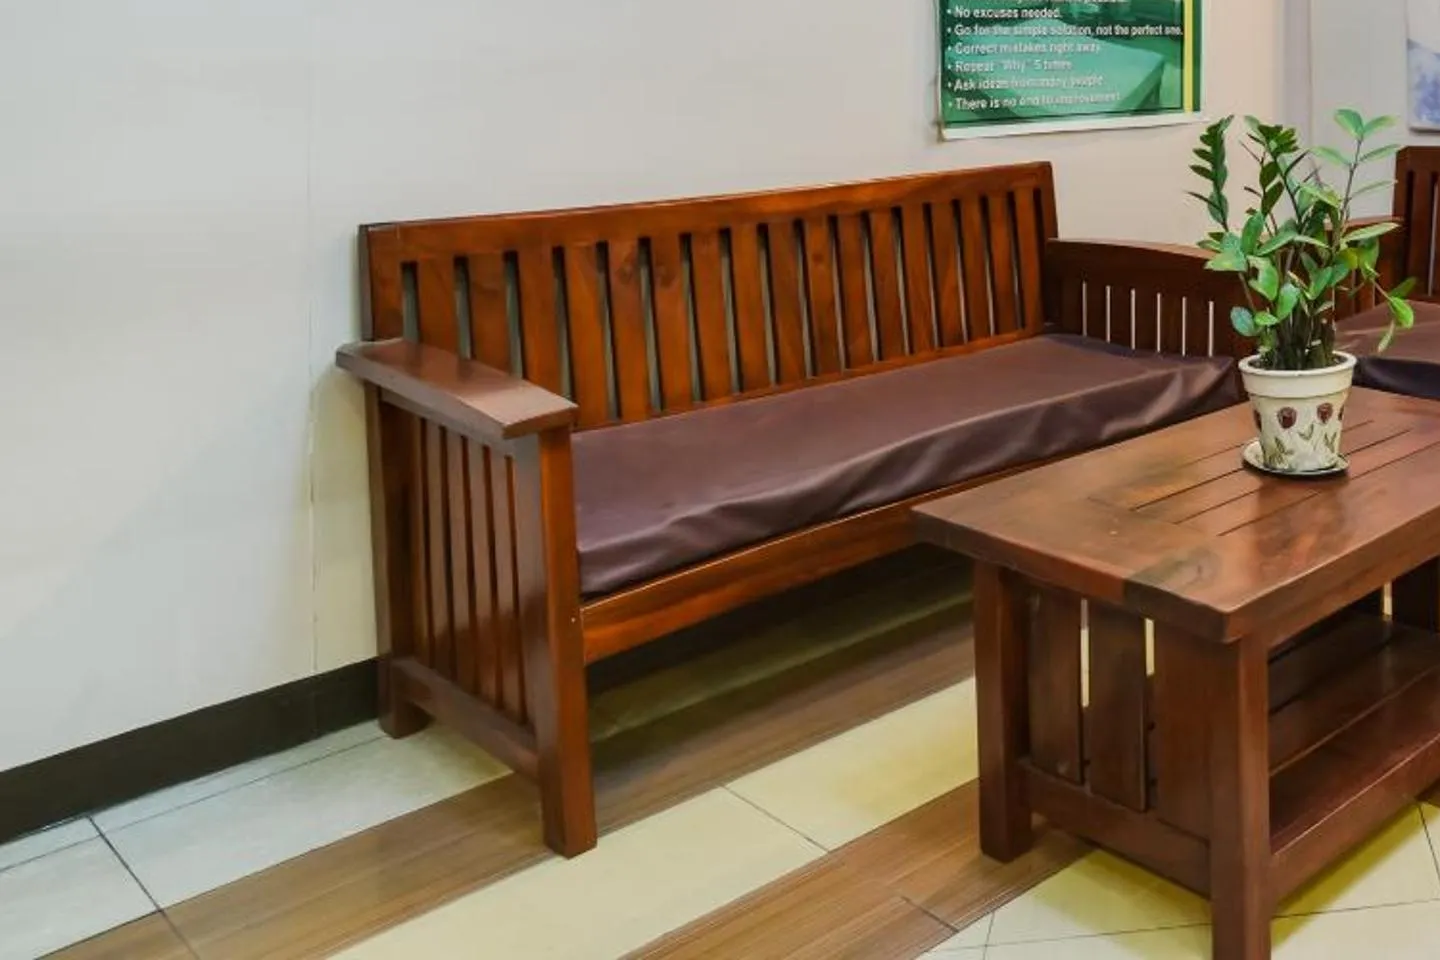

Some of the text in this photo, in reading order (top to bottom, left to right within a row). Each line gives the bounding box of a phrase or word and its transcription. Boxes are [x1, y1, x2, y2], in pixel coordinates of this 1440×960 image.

[954, 4, 970, 18] No
[973, 7, 1018, 19] excuses
[954, 24, 970, 36] Go
[1096, 24, 1112, 36] not
[1114, 24, 1129, 35] the
[1131, 24, 1163, 37] perfect
